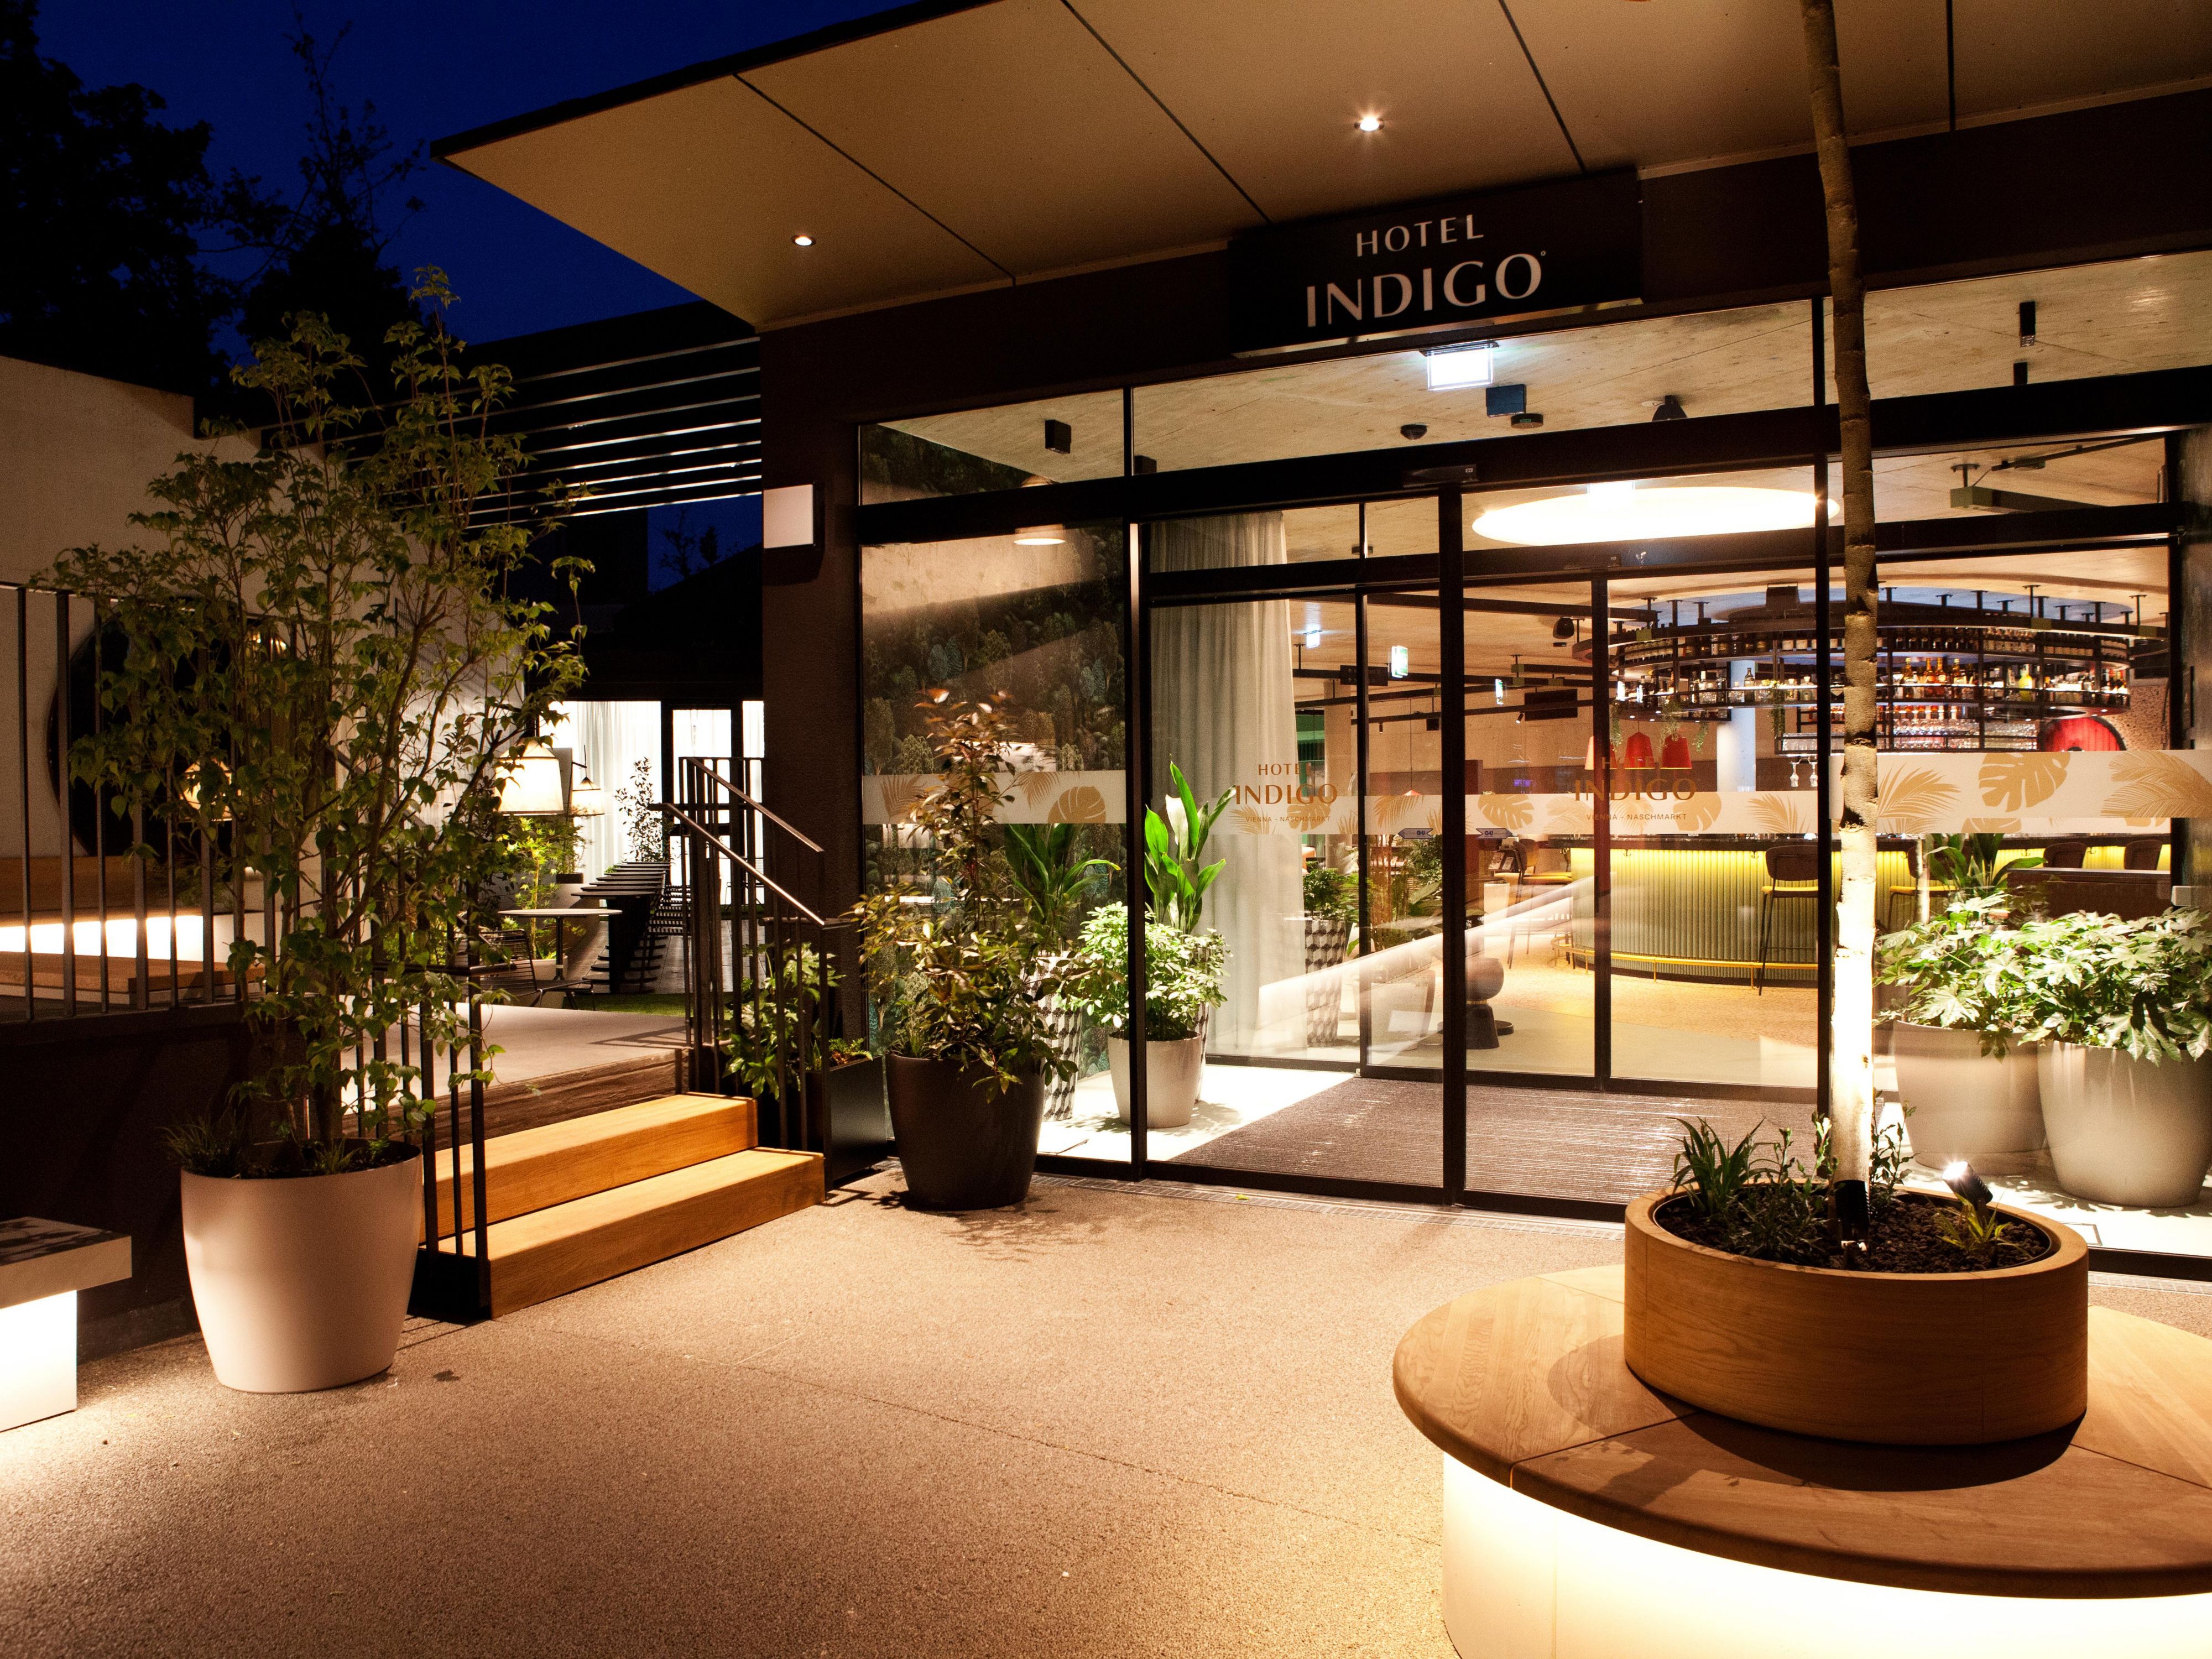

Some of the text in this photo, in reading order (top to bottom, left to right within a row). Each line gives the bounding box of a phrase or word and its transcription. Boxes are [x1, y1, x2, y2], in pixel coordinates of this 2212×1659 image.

[1357, 214, 1484, 257] HOTEL
[1307, 253, 1542, 327] INDIGO
[1236, 784, 1338, 804] INDIGO
[1575, 778, 1697, 801] INDIGO
